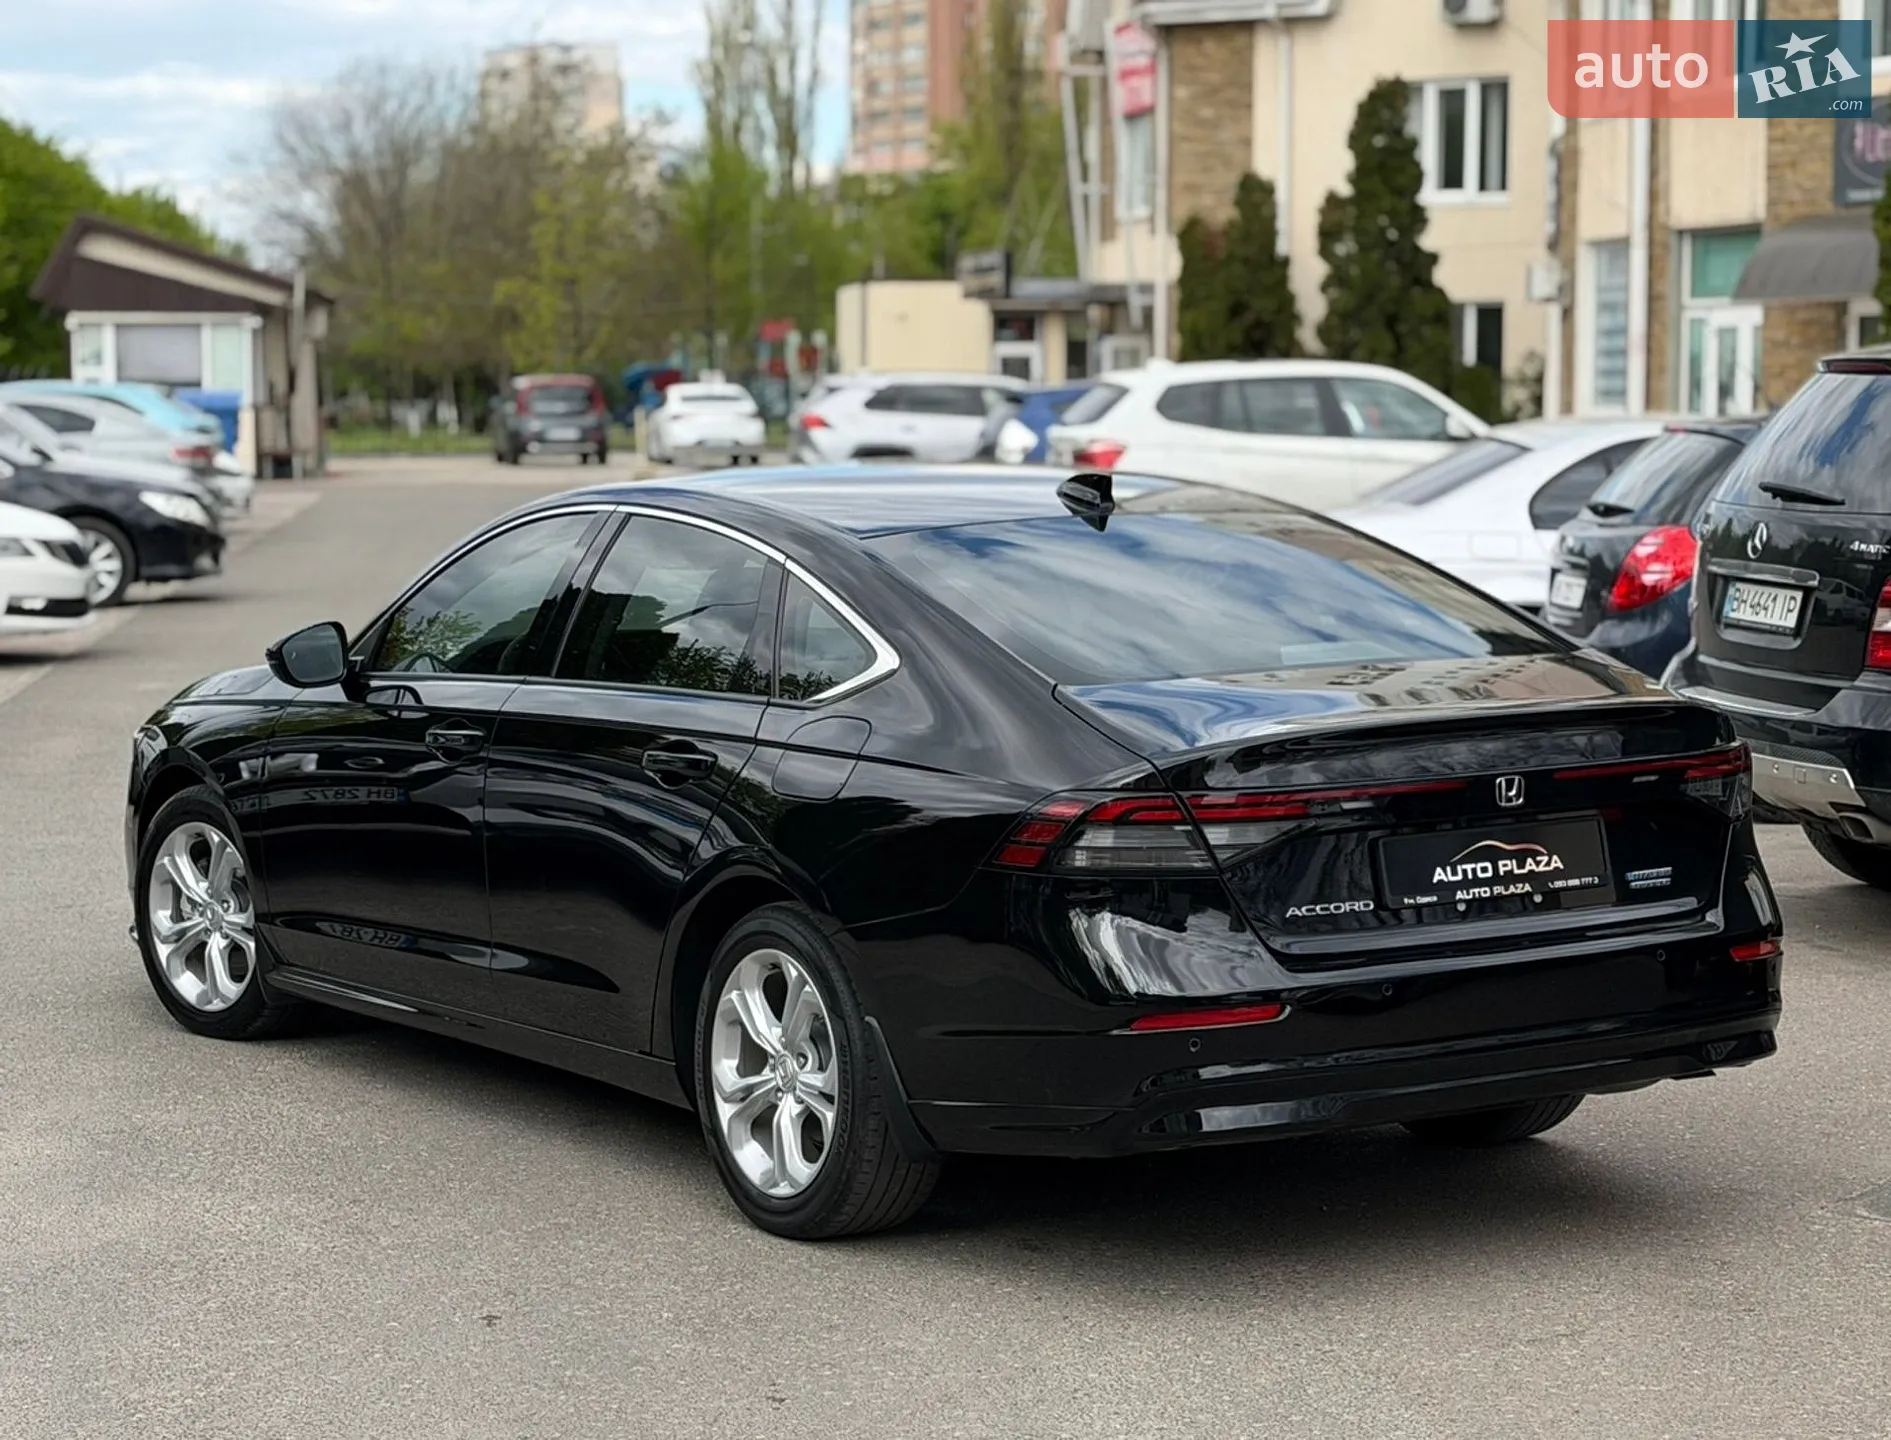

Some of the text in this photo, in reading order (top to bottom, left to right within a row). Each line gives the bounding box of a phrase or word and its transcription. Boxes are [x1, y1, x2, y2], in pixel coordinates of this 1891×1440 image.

[1432, 854, 1564, 884] AUTO PLAZA
[1455, 882, 1533, 901] AUTO PLAZA
[1285, 899, 1375, 918] ACCORD
